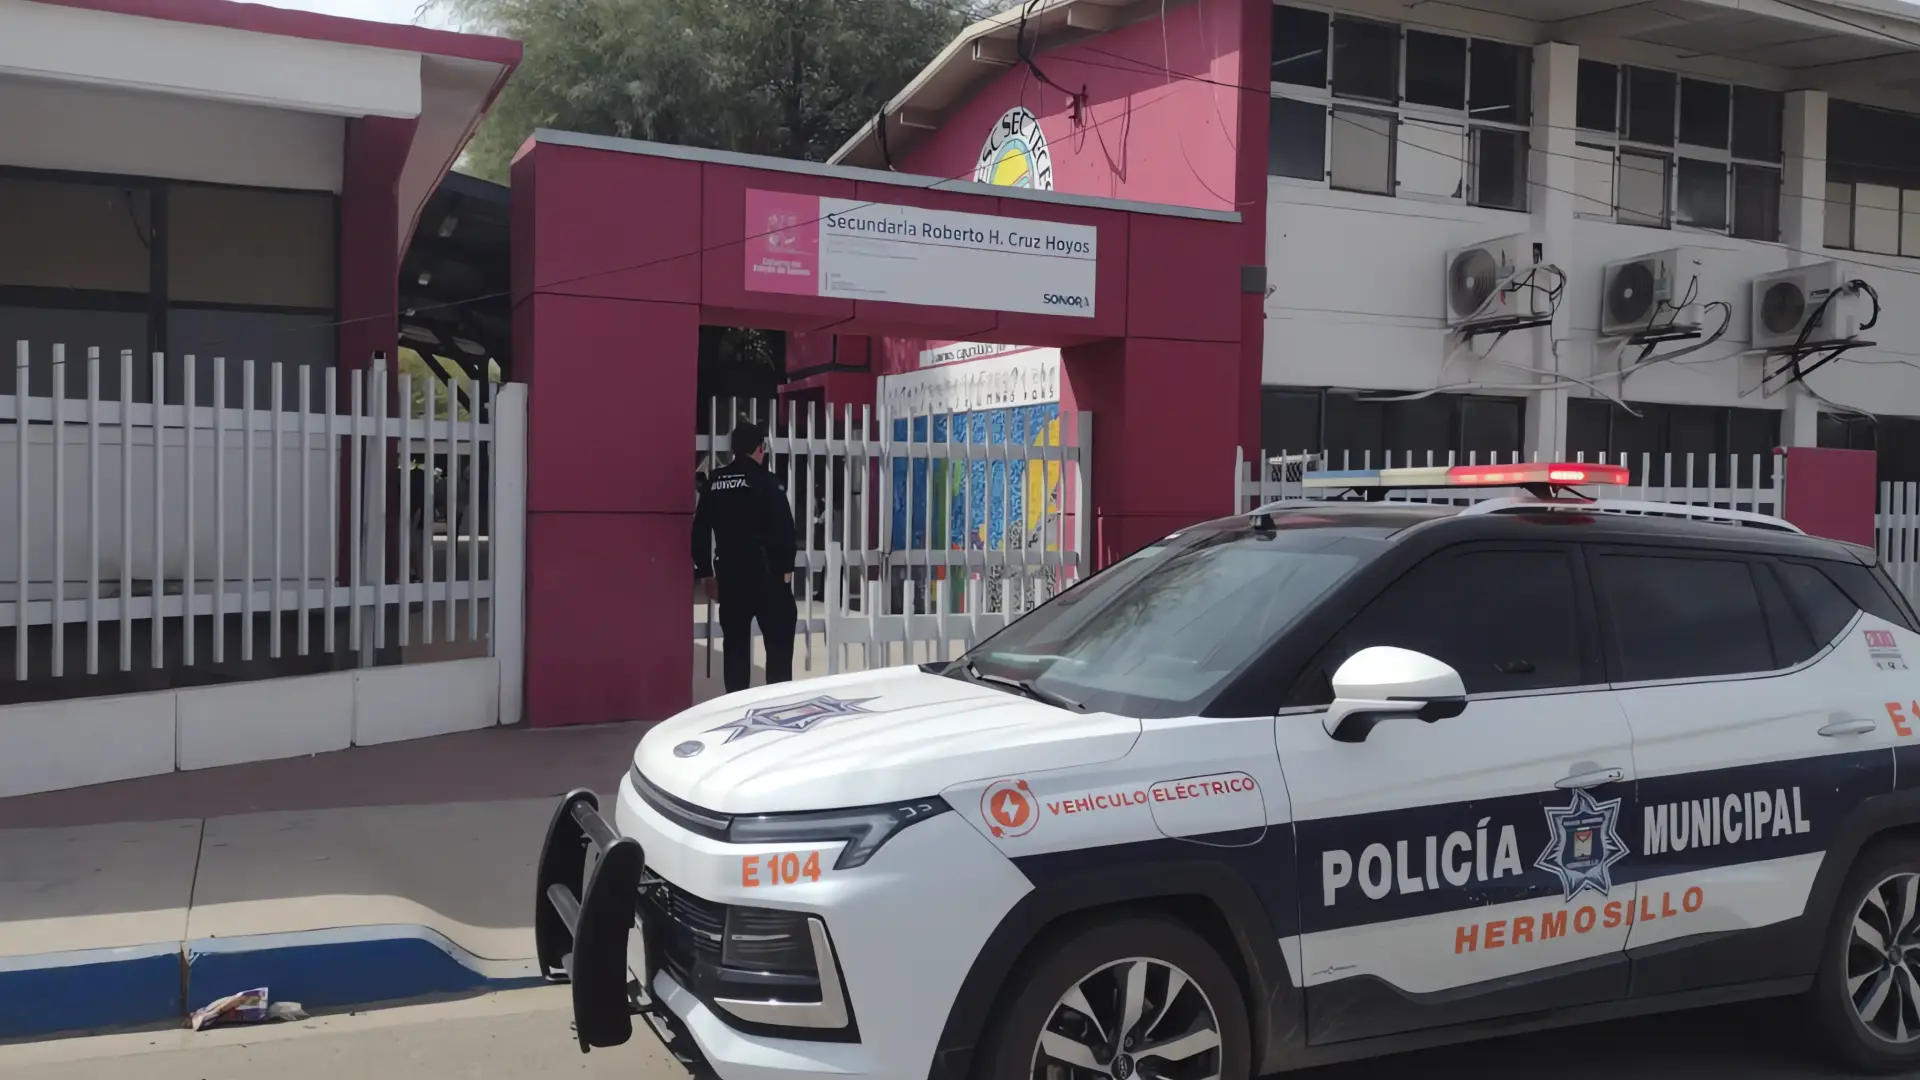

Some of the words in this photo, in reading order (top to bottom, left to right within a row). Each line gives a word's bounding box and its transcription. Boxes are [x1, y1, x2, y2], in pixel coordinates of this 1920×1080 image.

[827, 212, 917, 237] Secundaria
[922, 222, 984, 245] Roberto
[989, 230, 1004, 246] H.
[1008, 231, 1041, 249] Cruz
[1045, 236, 1090, 255] Hoyos
[1047, 791, 1148, 816] VEHÍCULO
[1152, 777, 1255, 802] ELÉCTRICO
[1322, 816, 1523, 906] POLICÍA
[1643, 786, 1811, 856] MUNICIPAL
[741, 856, 760, 888] E
[767, 851, 822, 885] 104
[1455, 886, 1703, 954] HERMOSILLO
